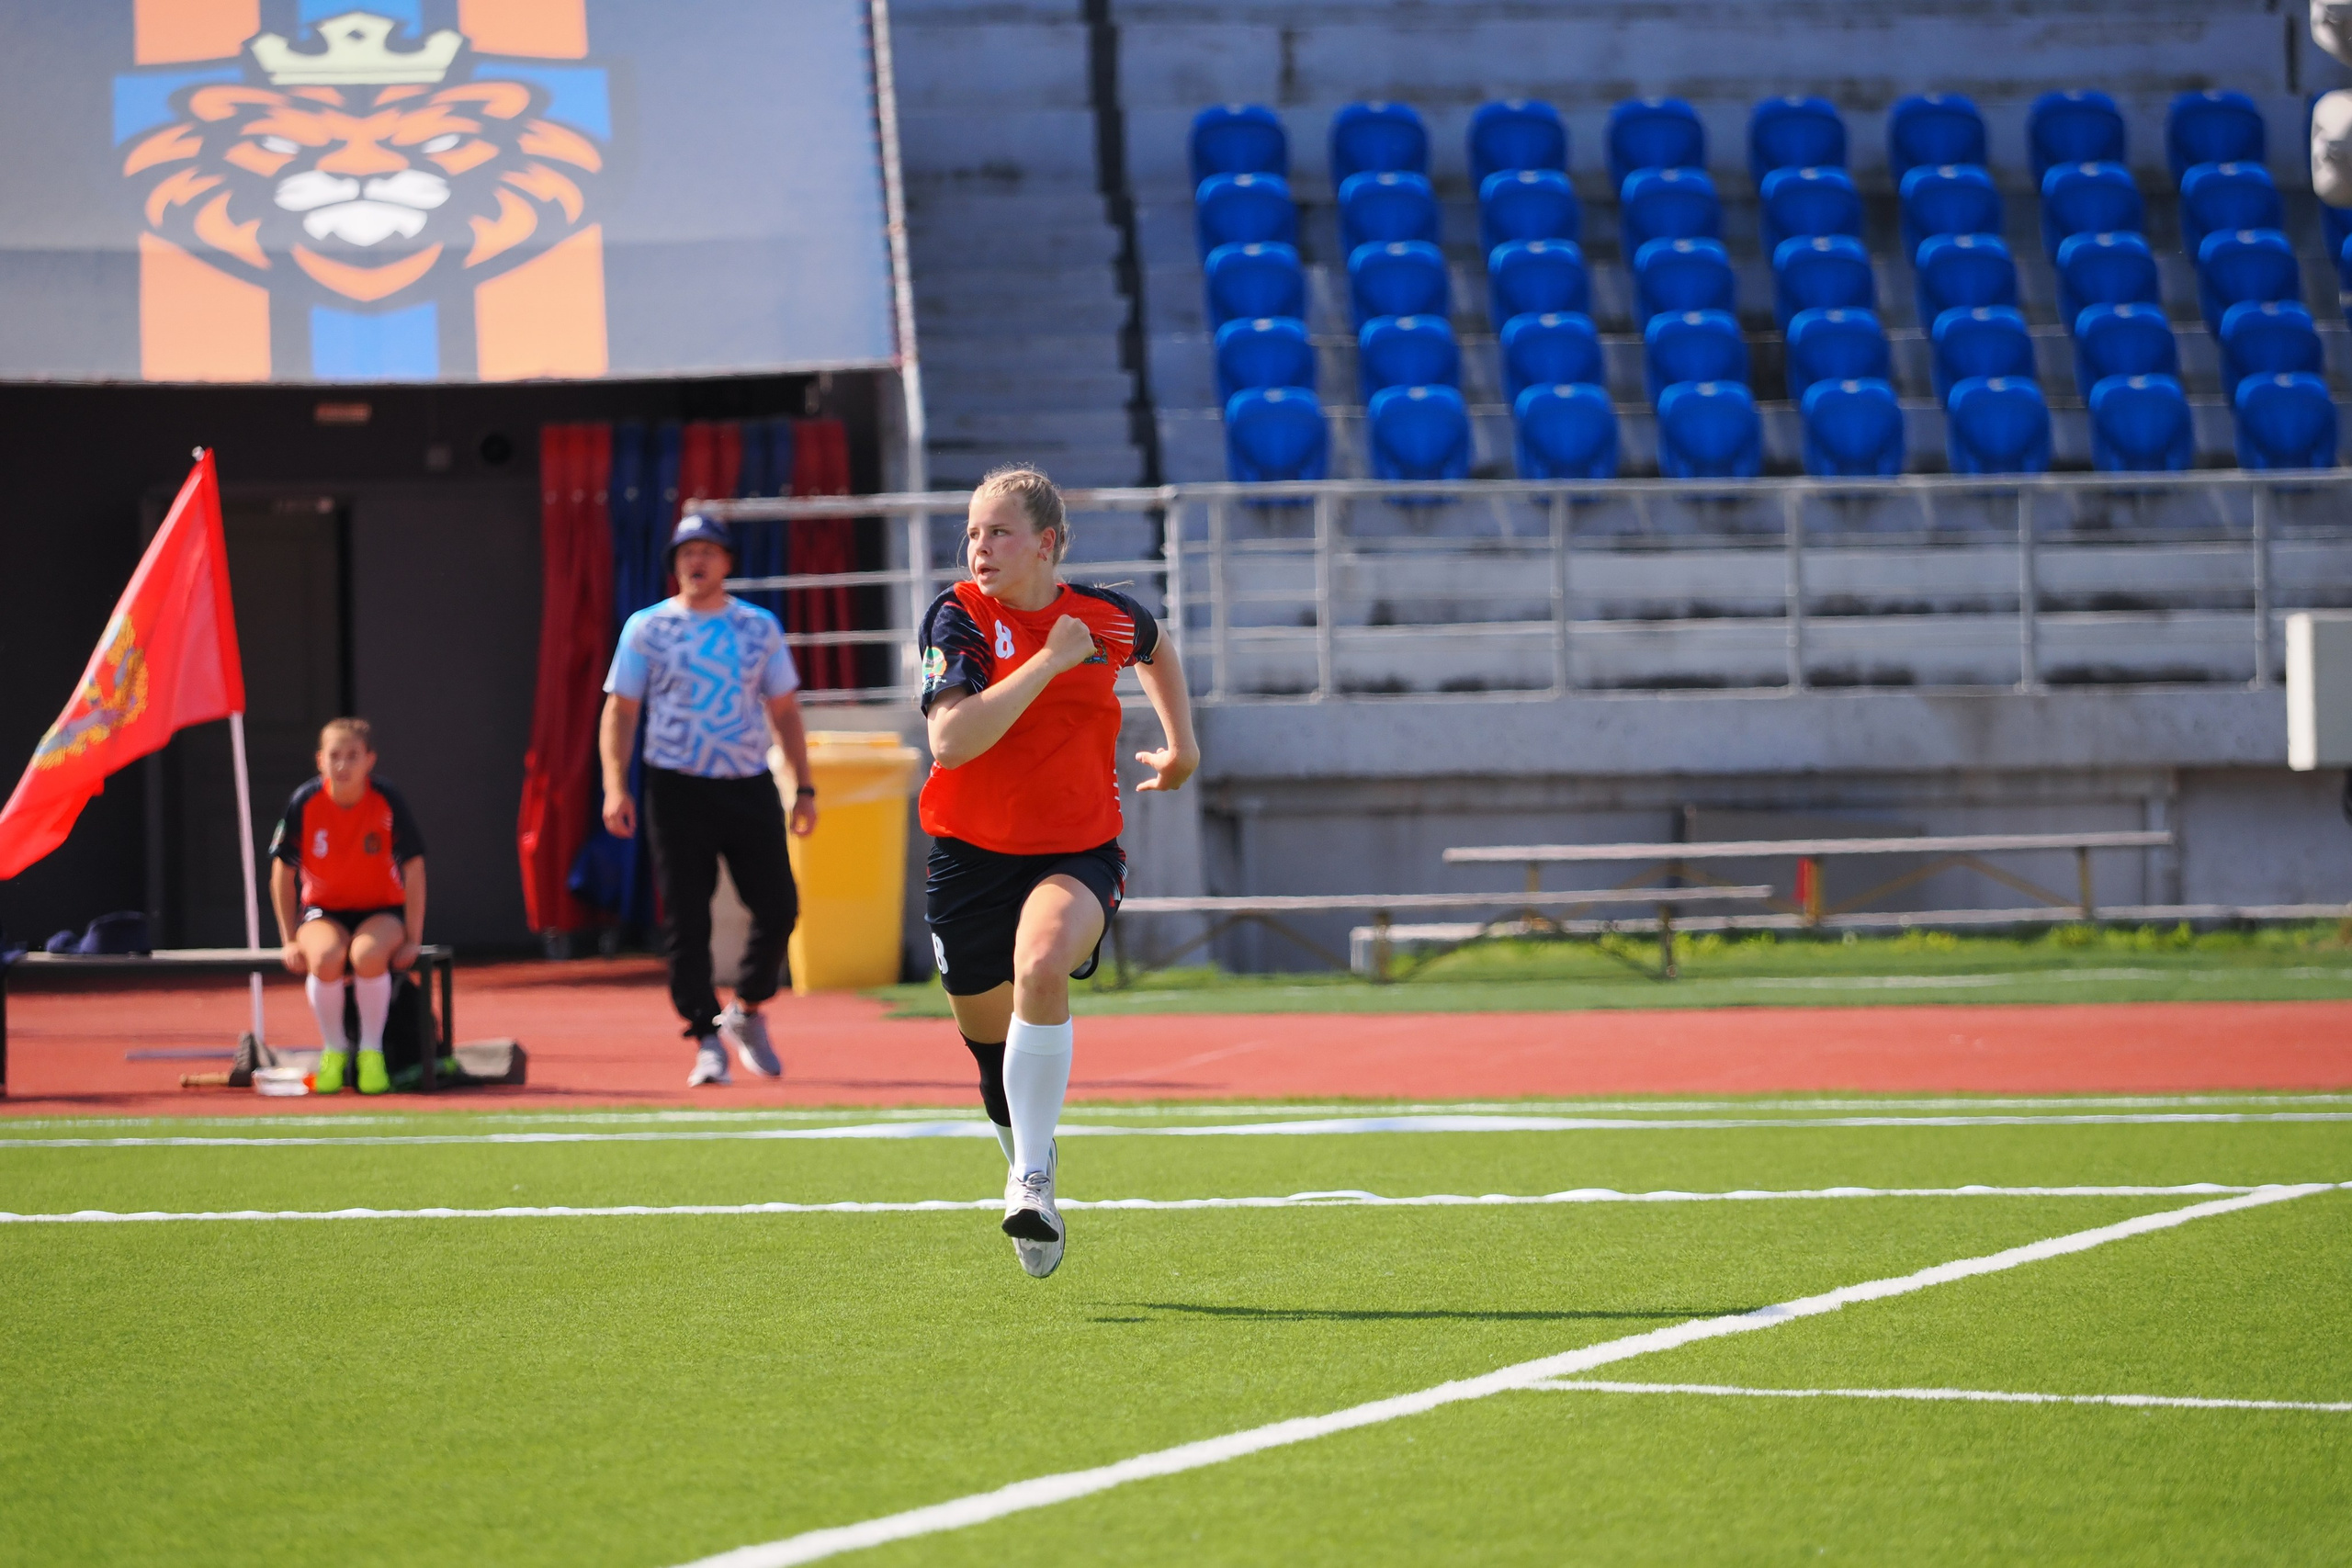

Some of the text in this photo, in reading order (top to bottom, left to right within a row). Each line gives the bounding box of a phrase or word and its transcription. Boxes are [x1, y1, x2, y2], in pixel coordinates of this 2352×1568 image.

[995, 619, 1015, 660] 8
[313, 829, 329, 859] 5
[932, 932, 949, 975] 8
